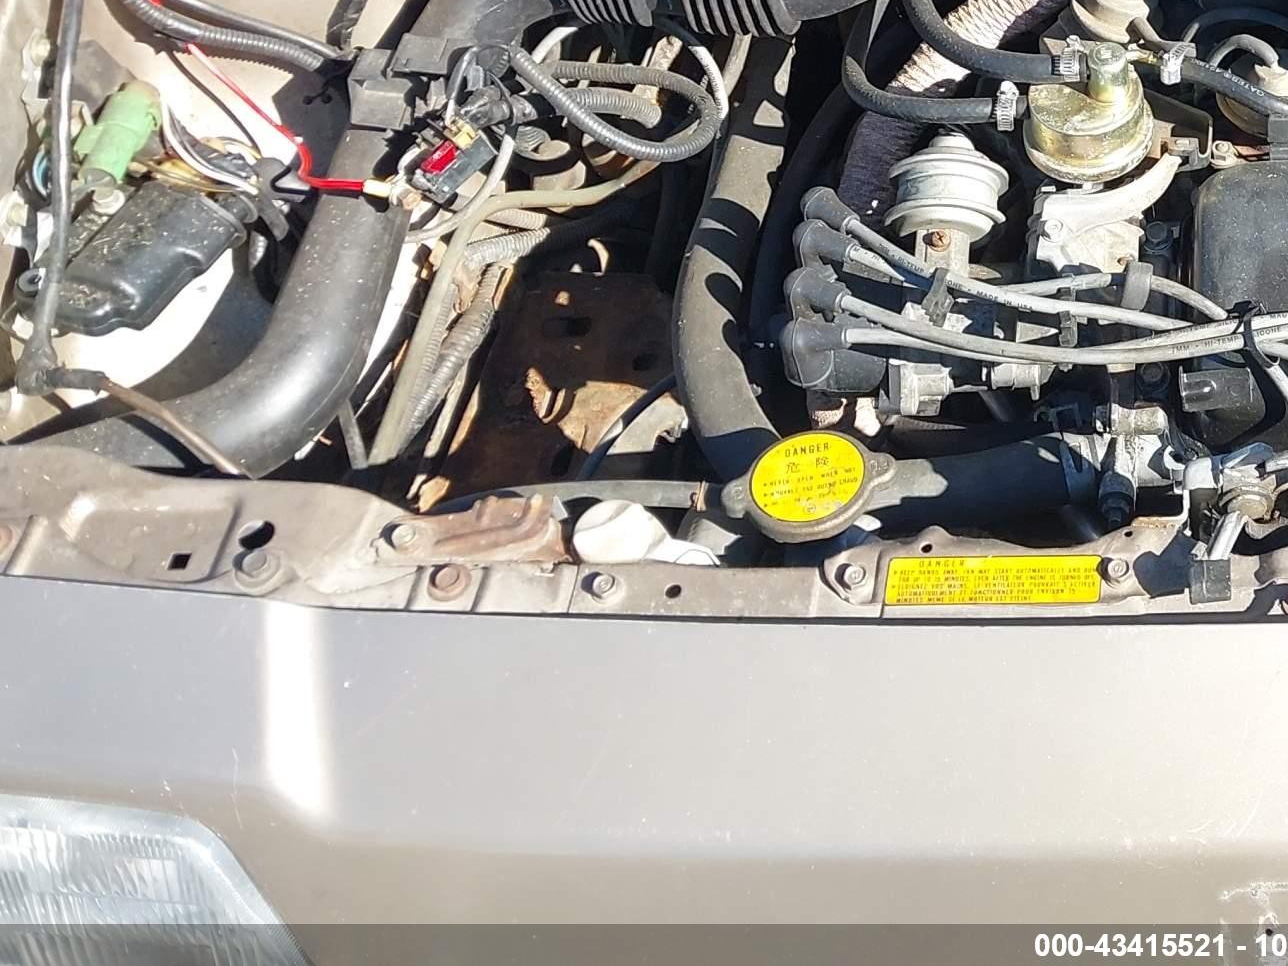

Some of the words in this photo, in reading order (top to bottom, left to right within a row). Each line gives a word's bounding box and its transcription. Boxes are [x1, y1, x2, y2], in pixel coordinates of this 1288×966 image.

[976, 290, 999, 302] MADE
[1204, 335, 1239, 347] HI-TEMP
[785, 442, 830, 458] DANGER
[919, 559, 965, 568] DANGER
